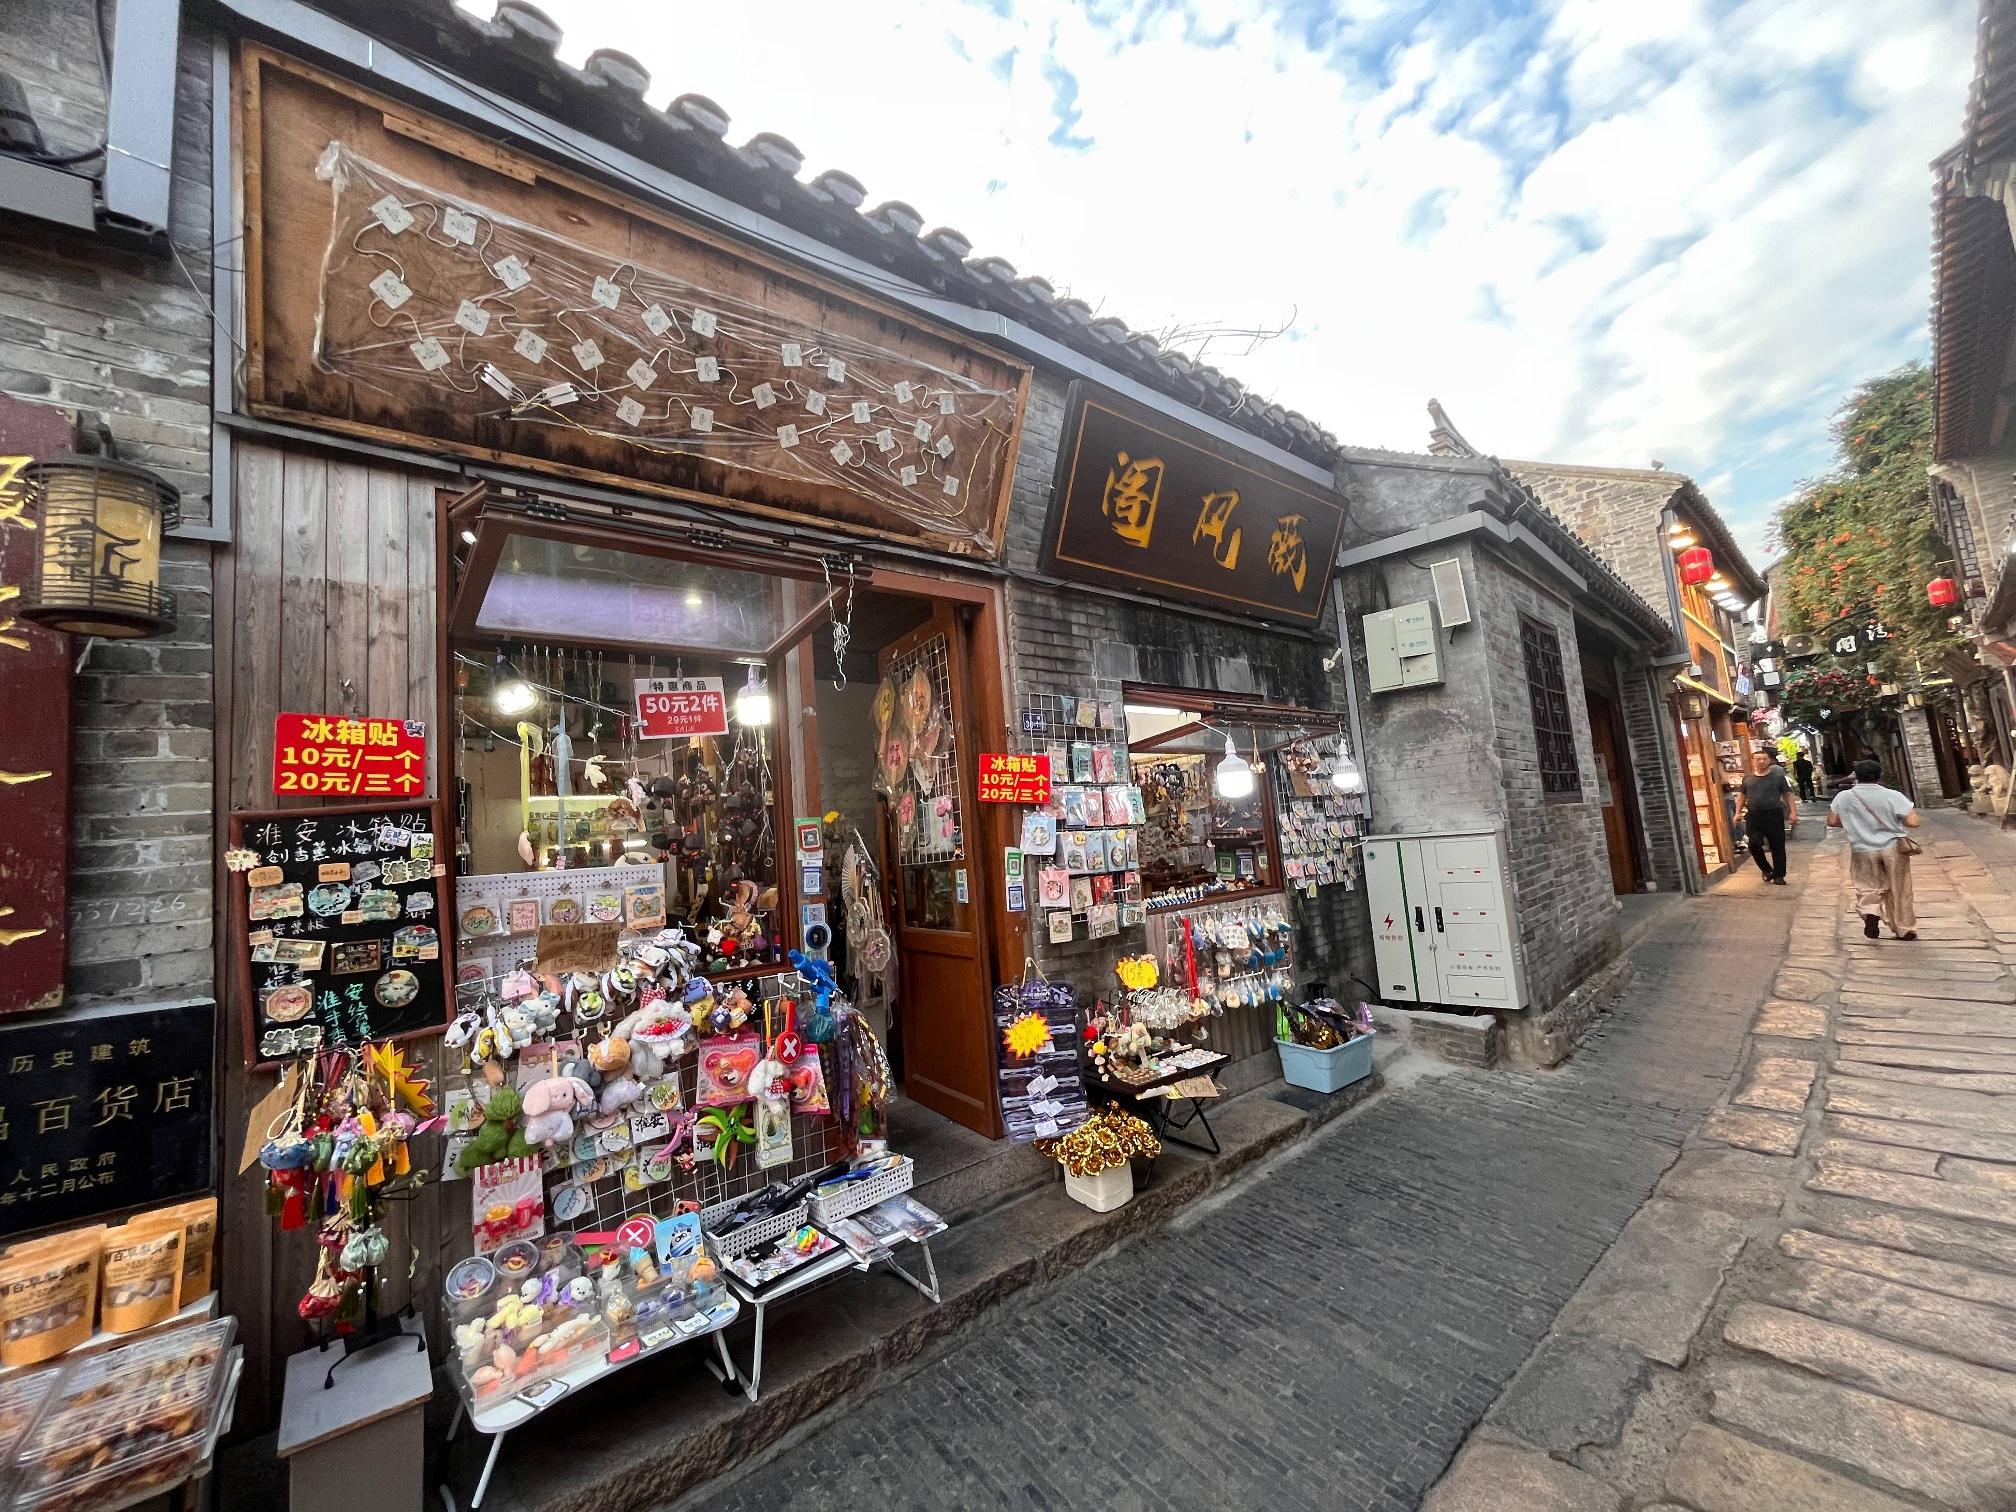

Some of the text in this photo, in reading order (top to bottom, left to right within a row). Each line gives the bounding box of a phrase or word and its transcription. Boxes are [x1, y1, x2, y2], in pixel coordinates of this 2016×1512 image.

[652, 680, 707, 692] 特惠商品
[646, 694, 720, 714] 50元2件
[301, 718, 399, 747] 冰箱贴
[282, 747, 422, 770] 10元/一个
[990, 755, 1037, 773] 冰箱贴
[279, 771, 421, 794] 20元/三个
[981, 773, 1049, 788] 10元/一个
[981, 787, 1049, 802] 20元/三个
[9, 1037, 152, 1074] 历史建筑
[634, 1112, 665, 1132] 淮安
[9, 1151, 117, 1186] 人民政府
[0, 1170, 116, 1206] 年十二月公布
